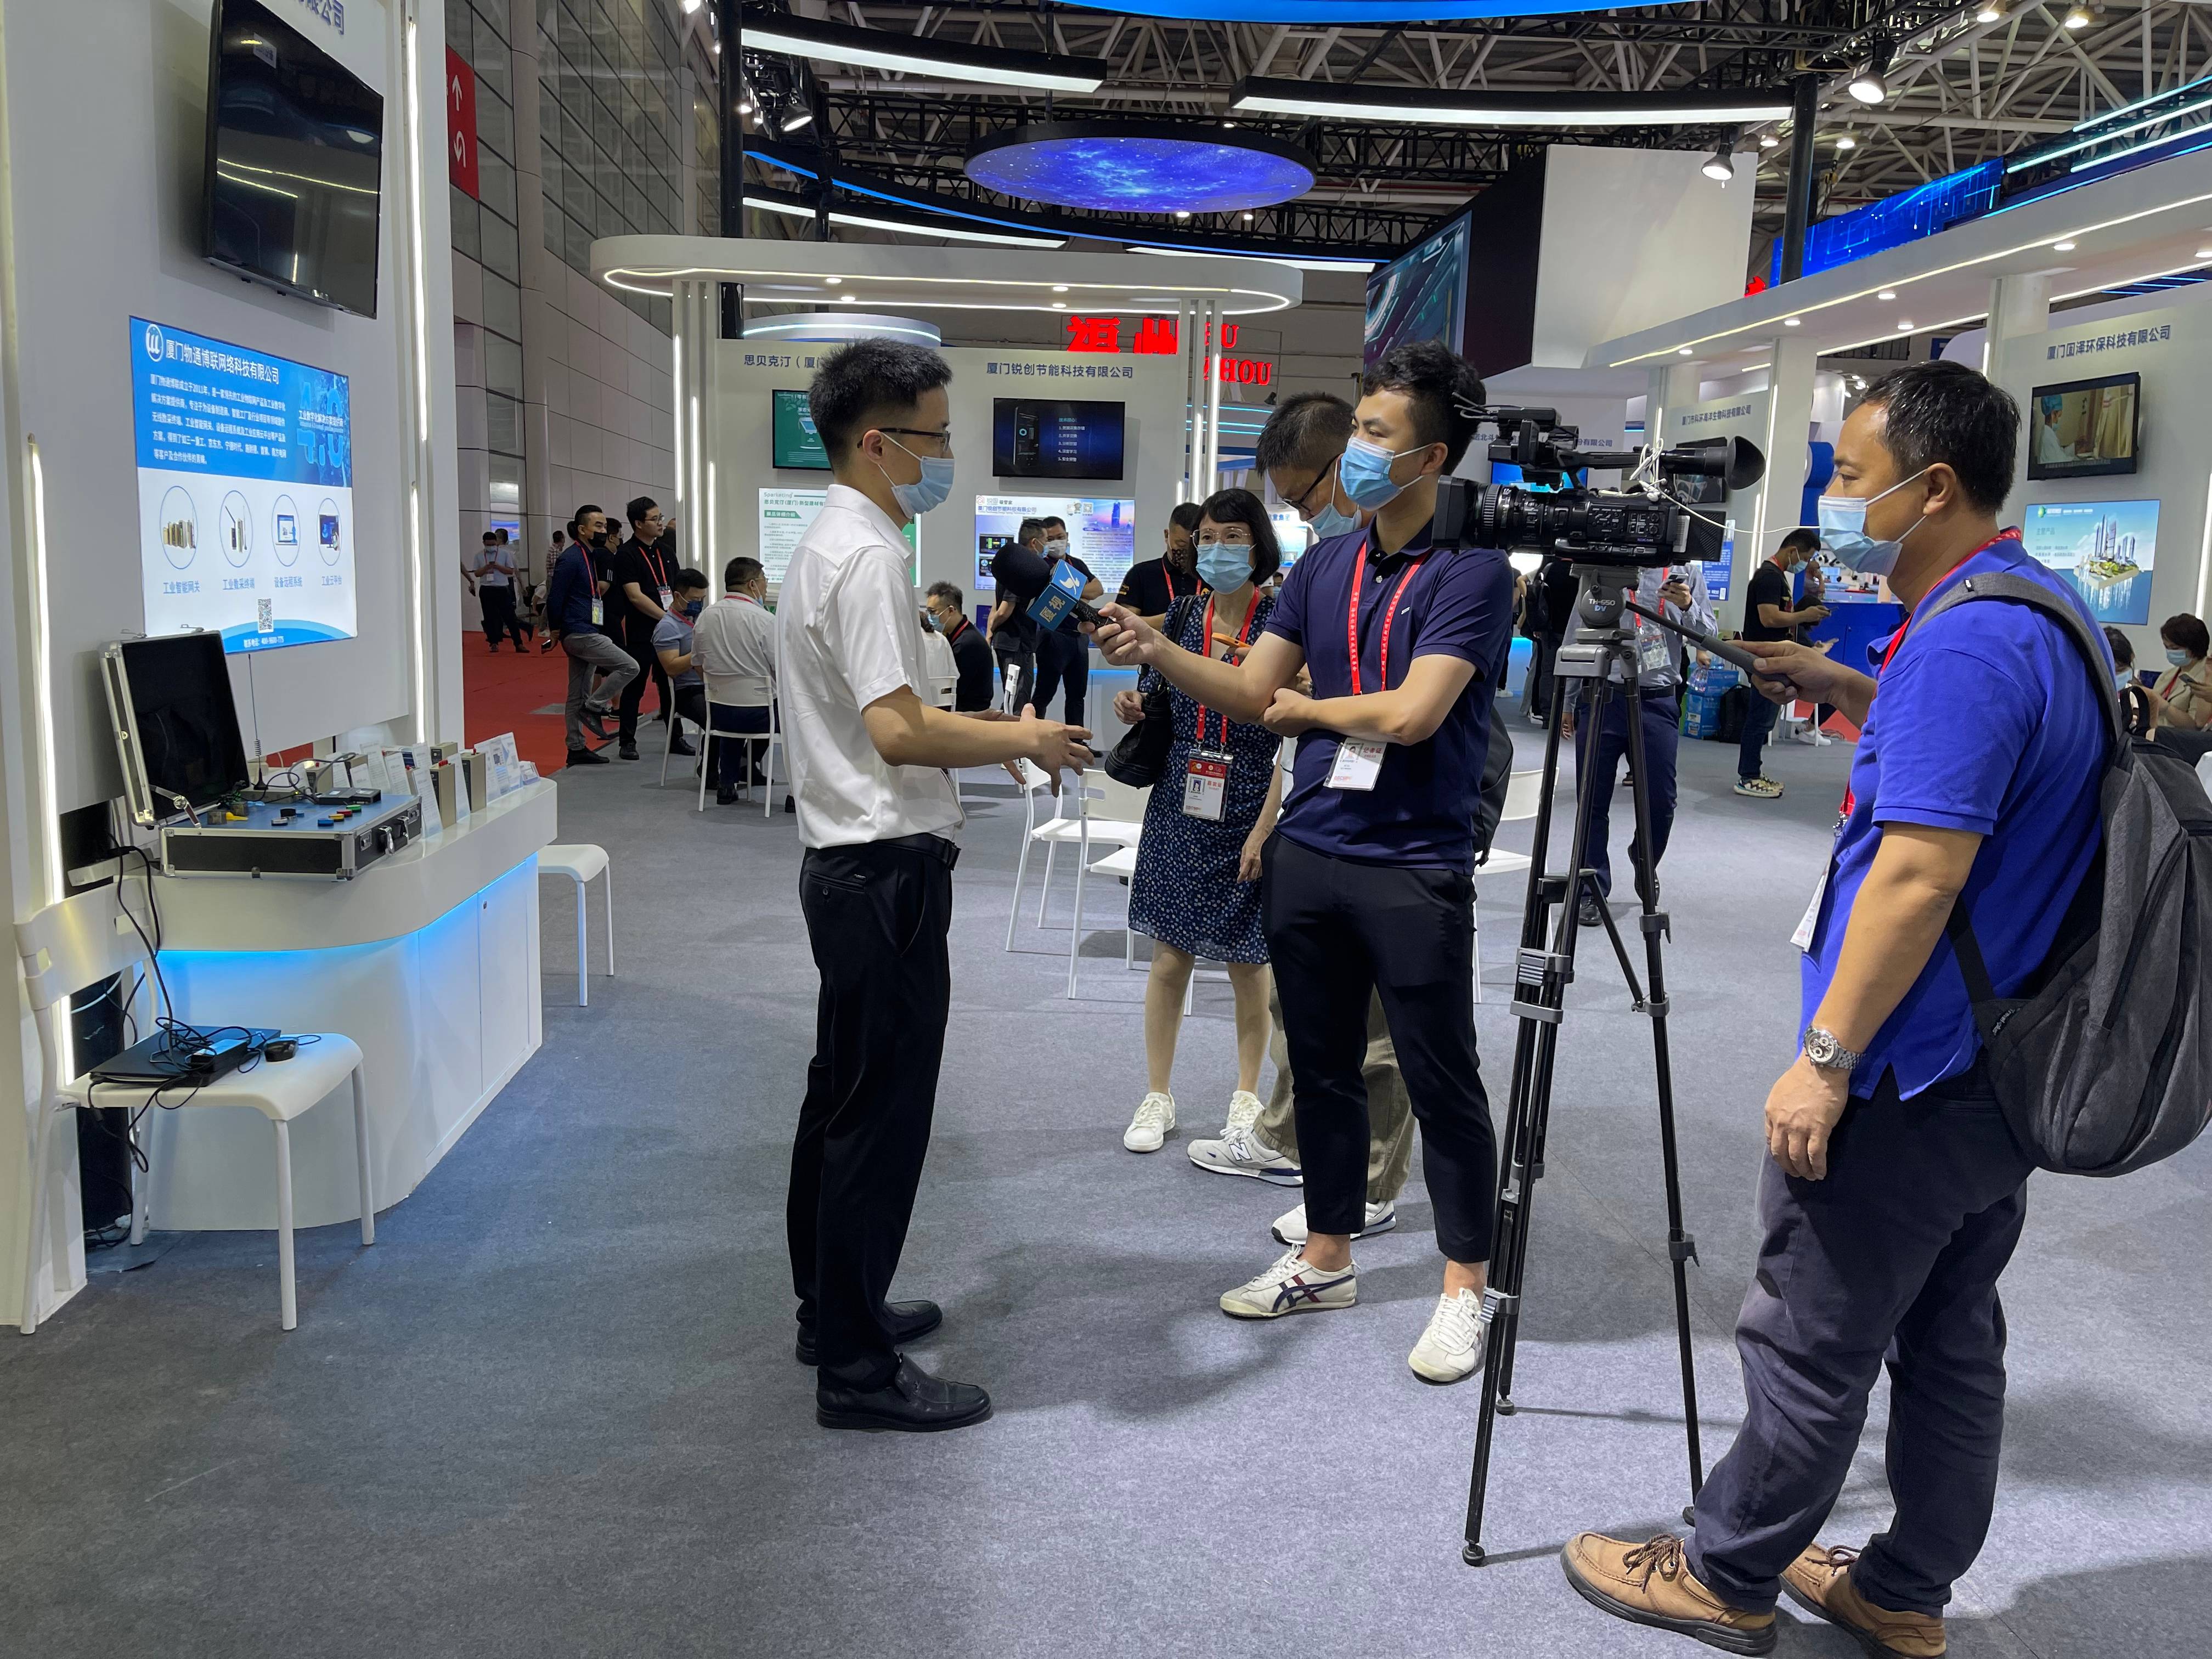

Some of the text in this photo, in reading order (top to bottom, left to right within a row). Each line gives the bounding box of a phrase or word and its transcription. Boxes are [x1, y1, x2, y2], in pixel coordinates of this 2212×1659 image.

[166, 340, 279, 384] 厦门物通博联网络科技有限公司
[986, 362, 1133, 378] 厦门锐创节能科技有限公司
[163, 580, 200, 594] 工业智能网关
